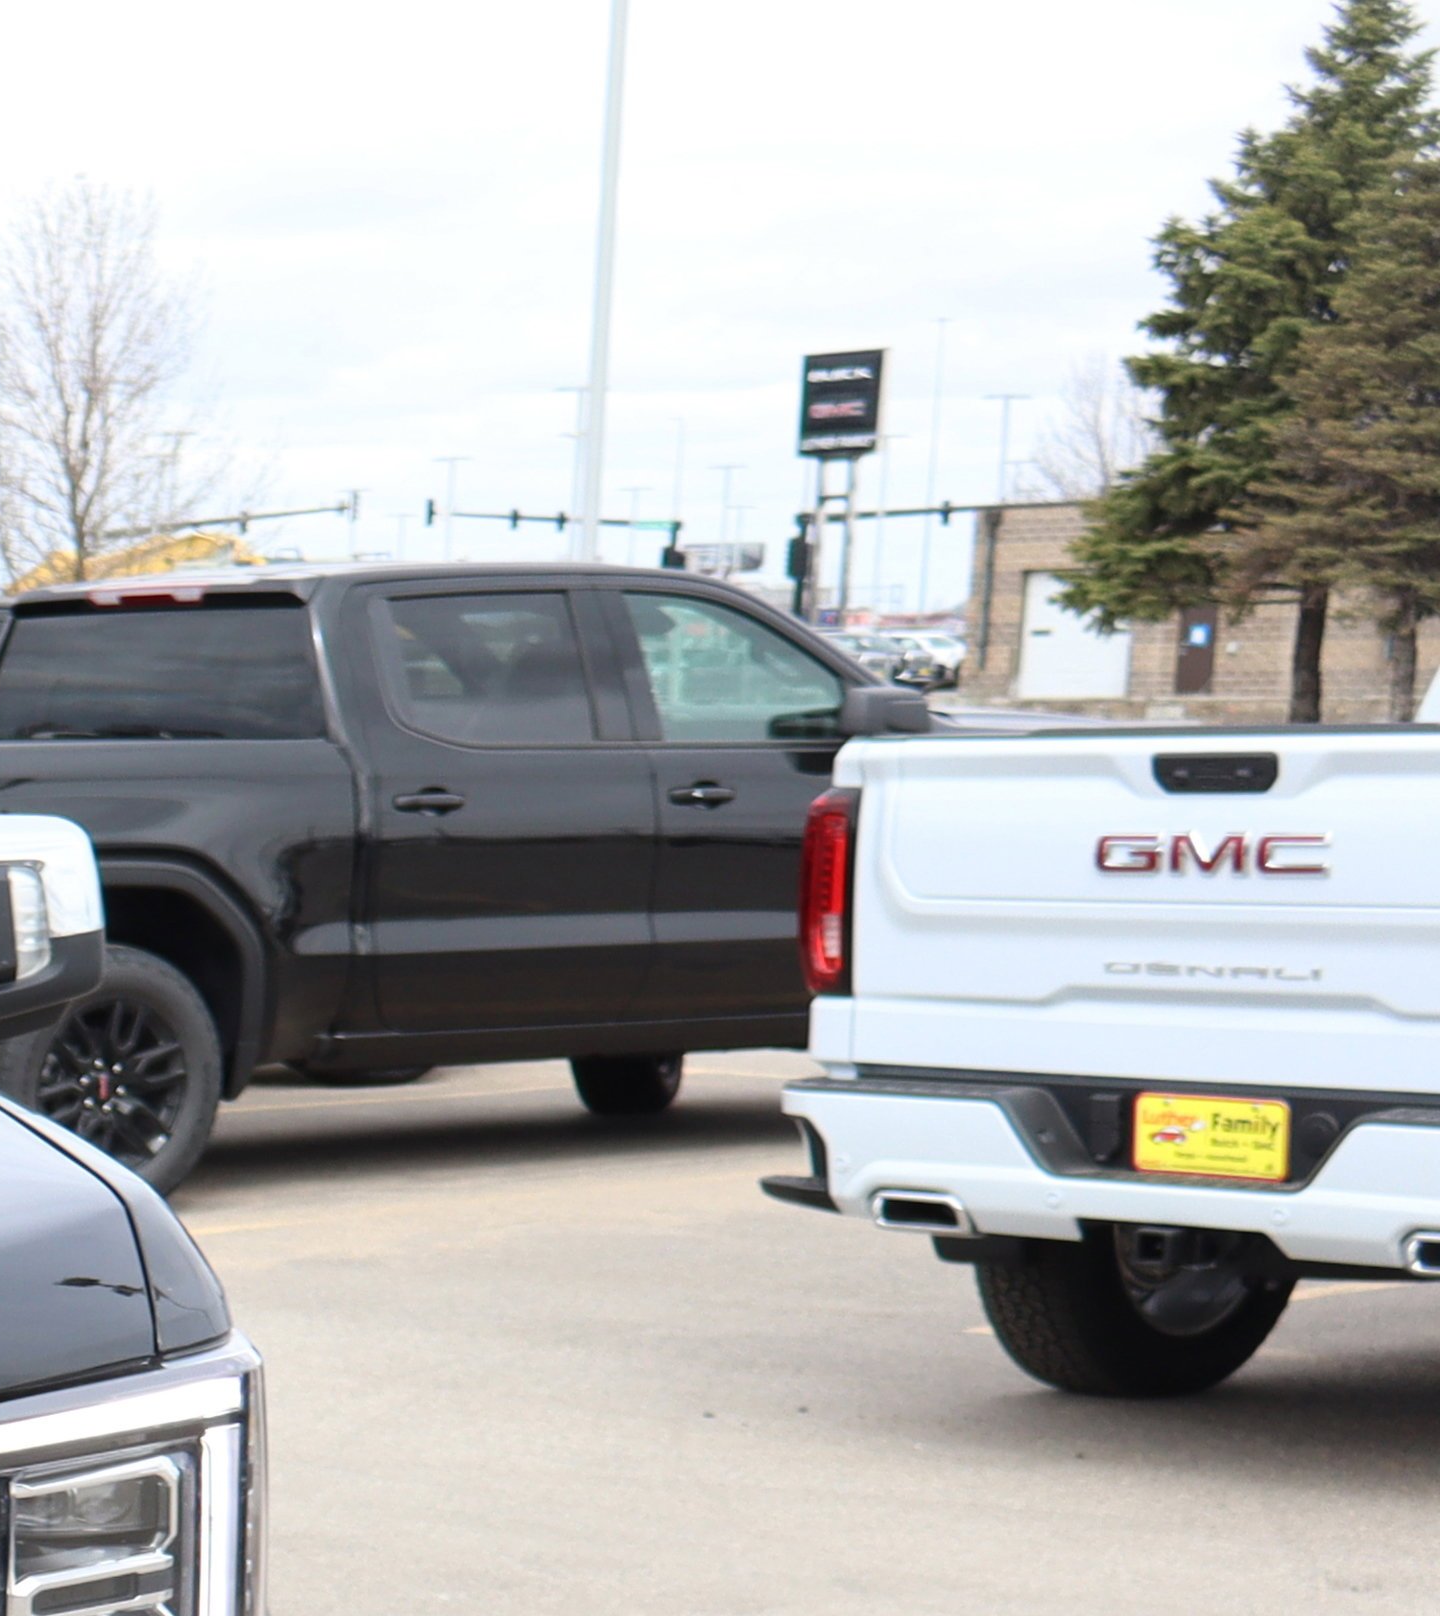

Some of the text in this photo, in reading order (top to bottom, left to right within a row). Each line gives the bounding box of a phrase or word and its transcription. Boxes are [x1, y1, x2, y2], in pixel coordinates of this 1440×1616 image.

[1095, 831, 1332, 875] GMC
[1104, 961, 1323, 981] DENALI
[1211, 1113, 1279, 1139] Family
